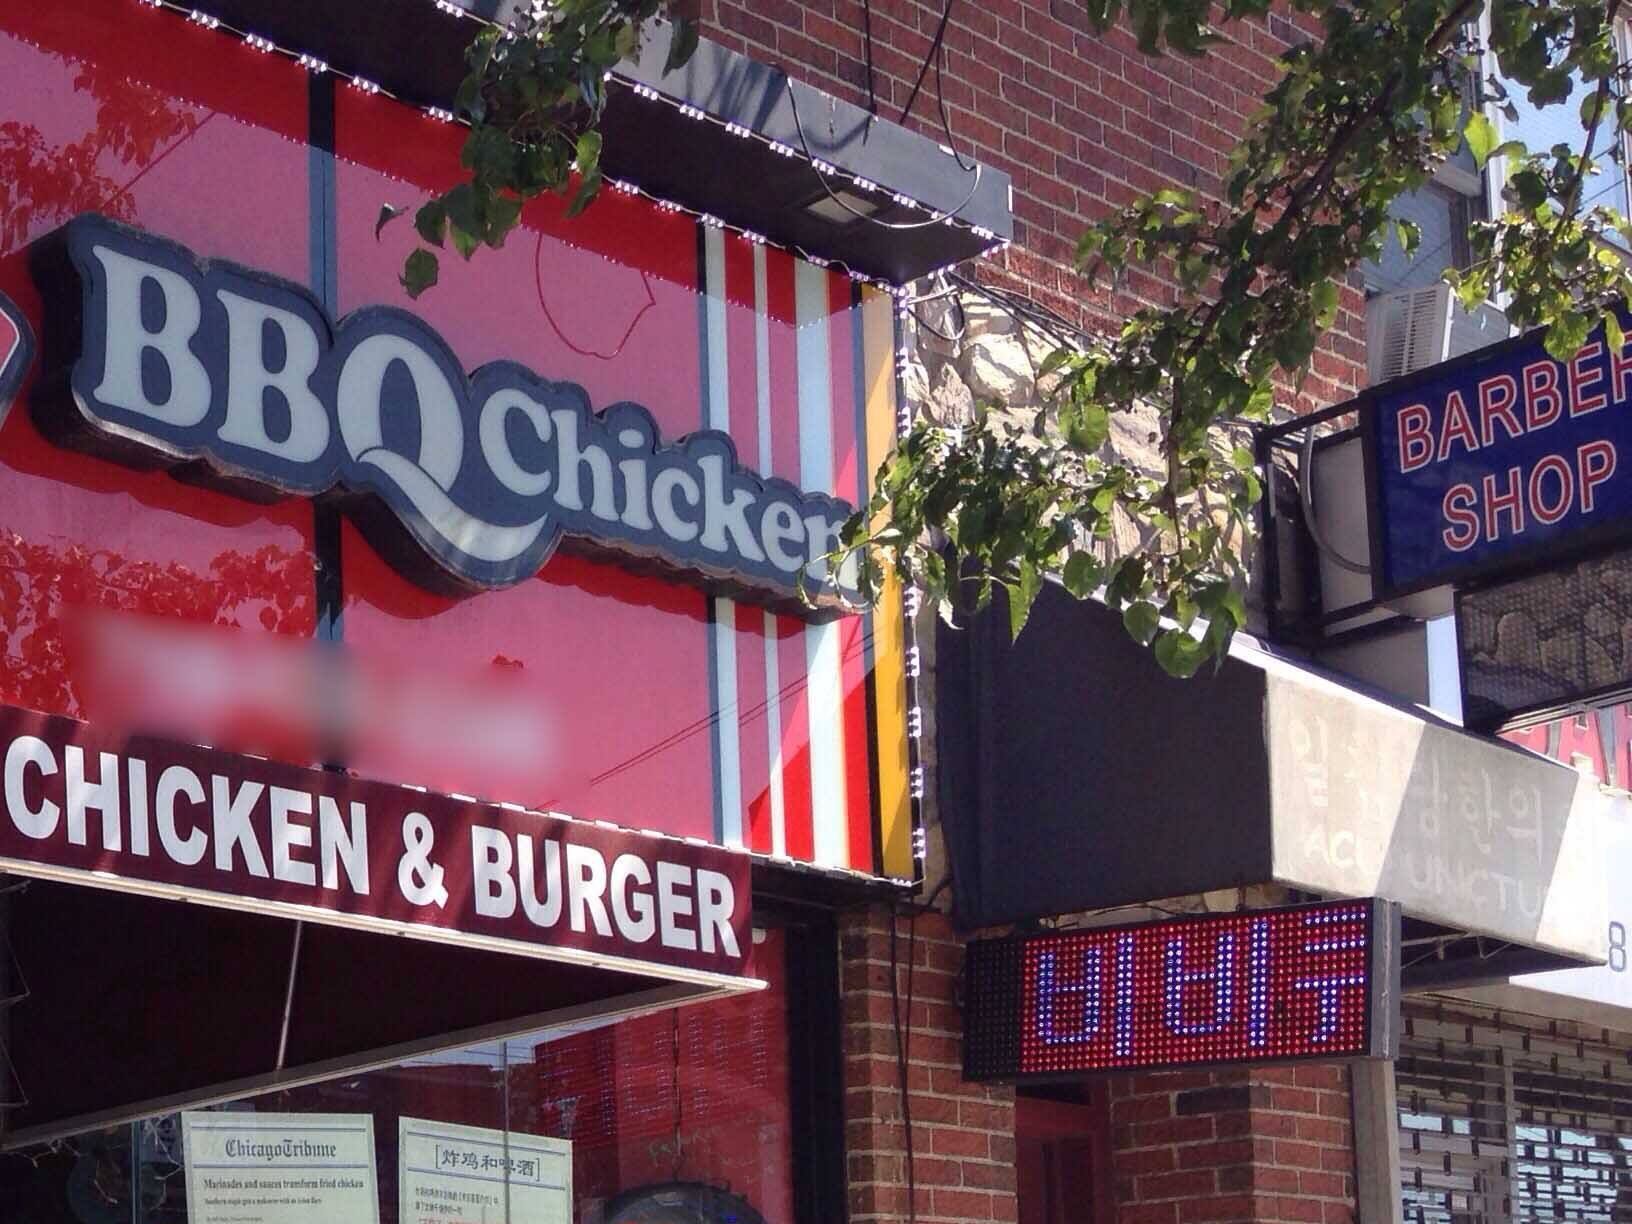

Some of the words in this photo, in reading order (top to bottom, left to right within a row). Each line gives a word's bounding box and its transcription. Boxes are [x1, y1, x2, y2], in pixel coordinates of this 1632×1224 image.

[90, 244, 548, 563] BBQ
[478, 386, 860, 600] Chicken
[1442, 440, 1617, 552] SHOP
[3, 735, 371, 895] CHICKEN
[397, 811, 450, 908] &
[469, 825, 743, 959] BURGER
